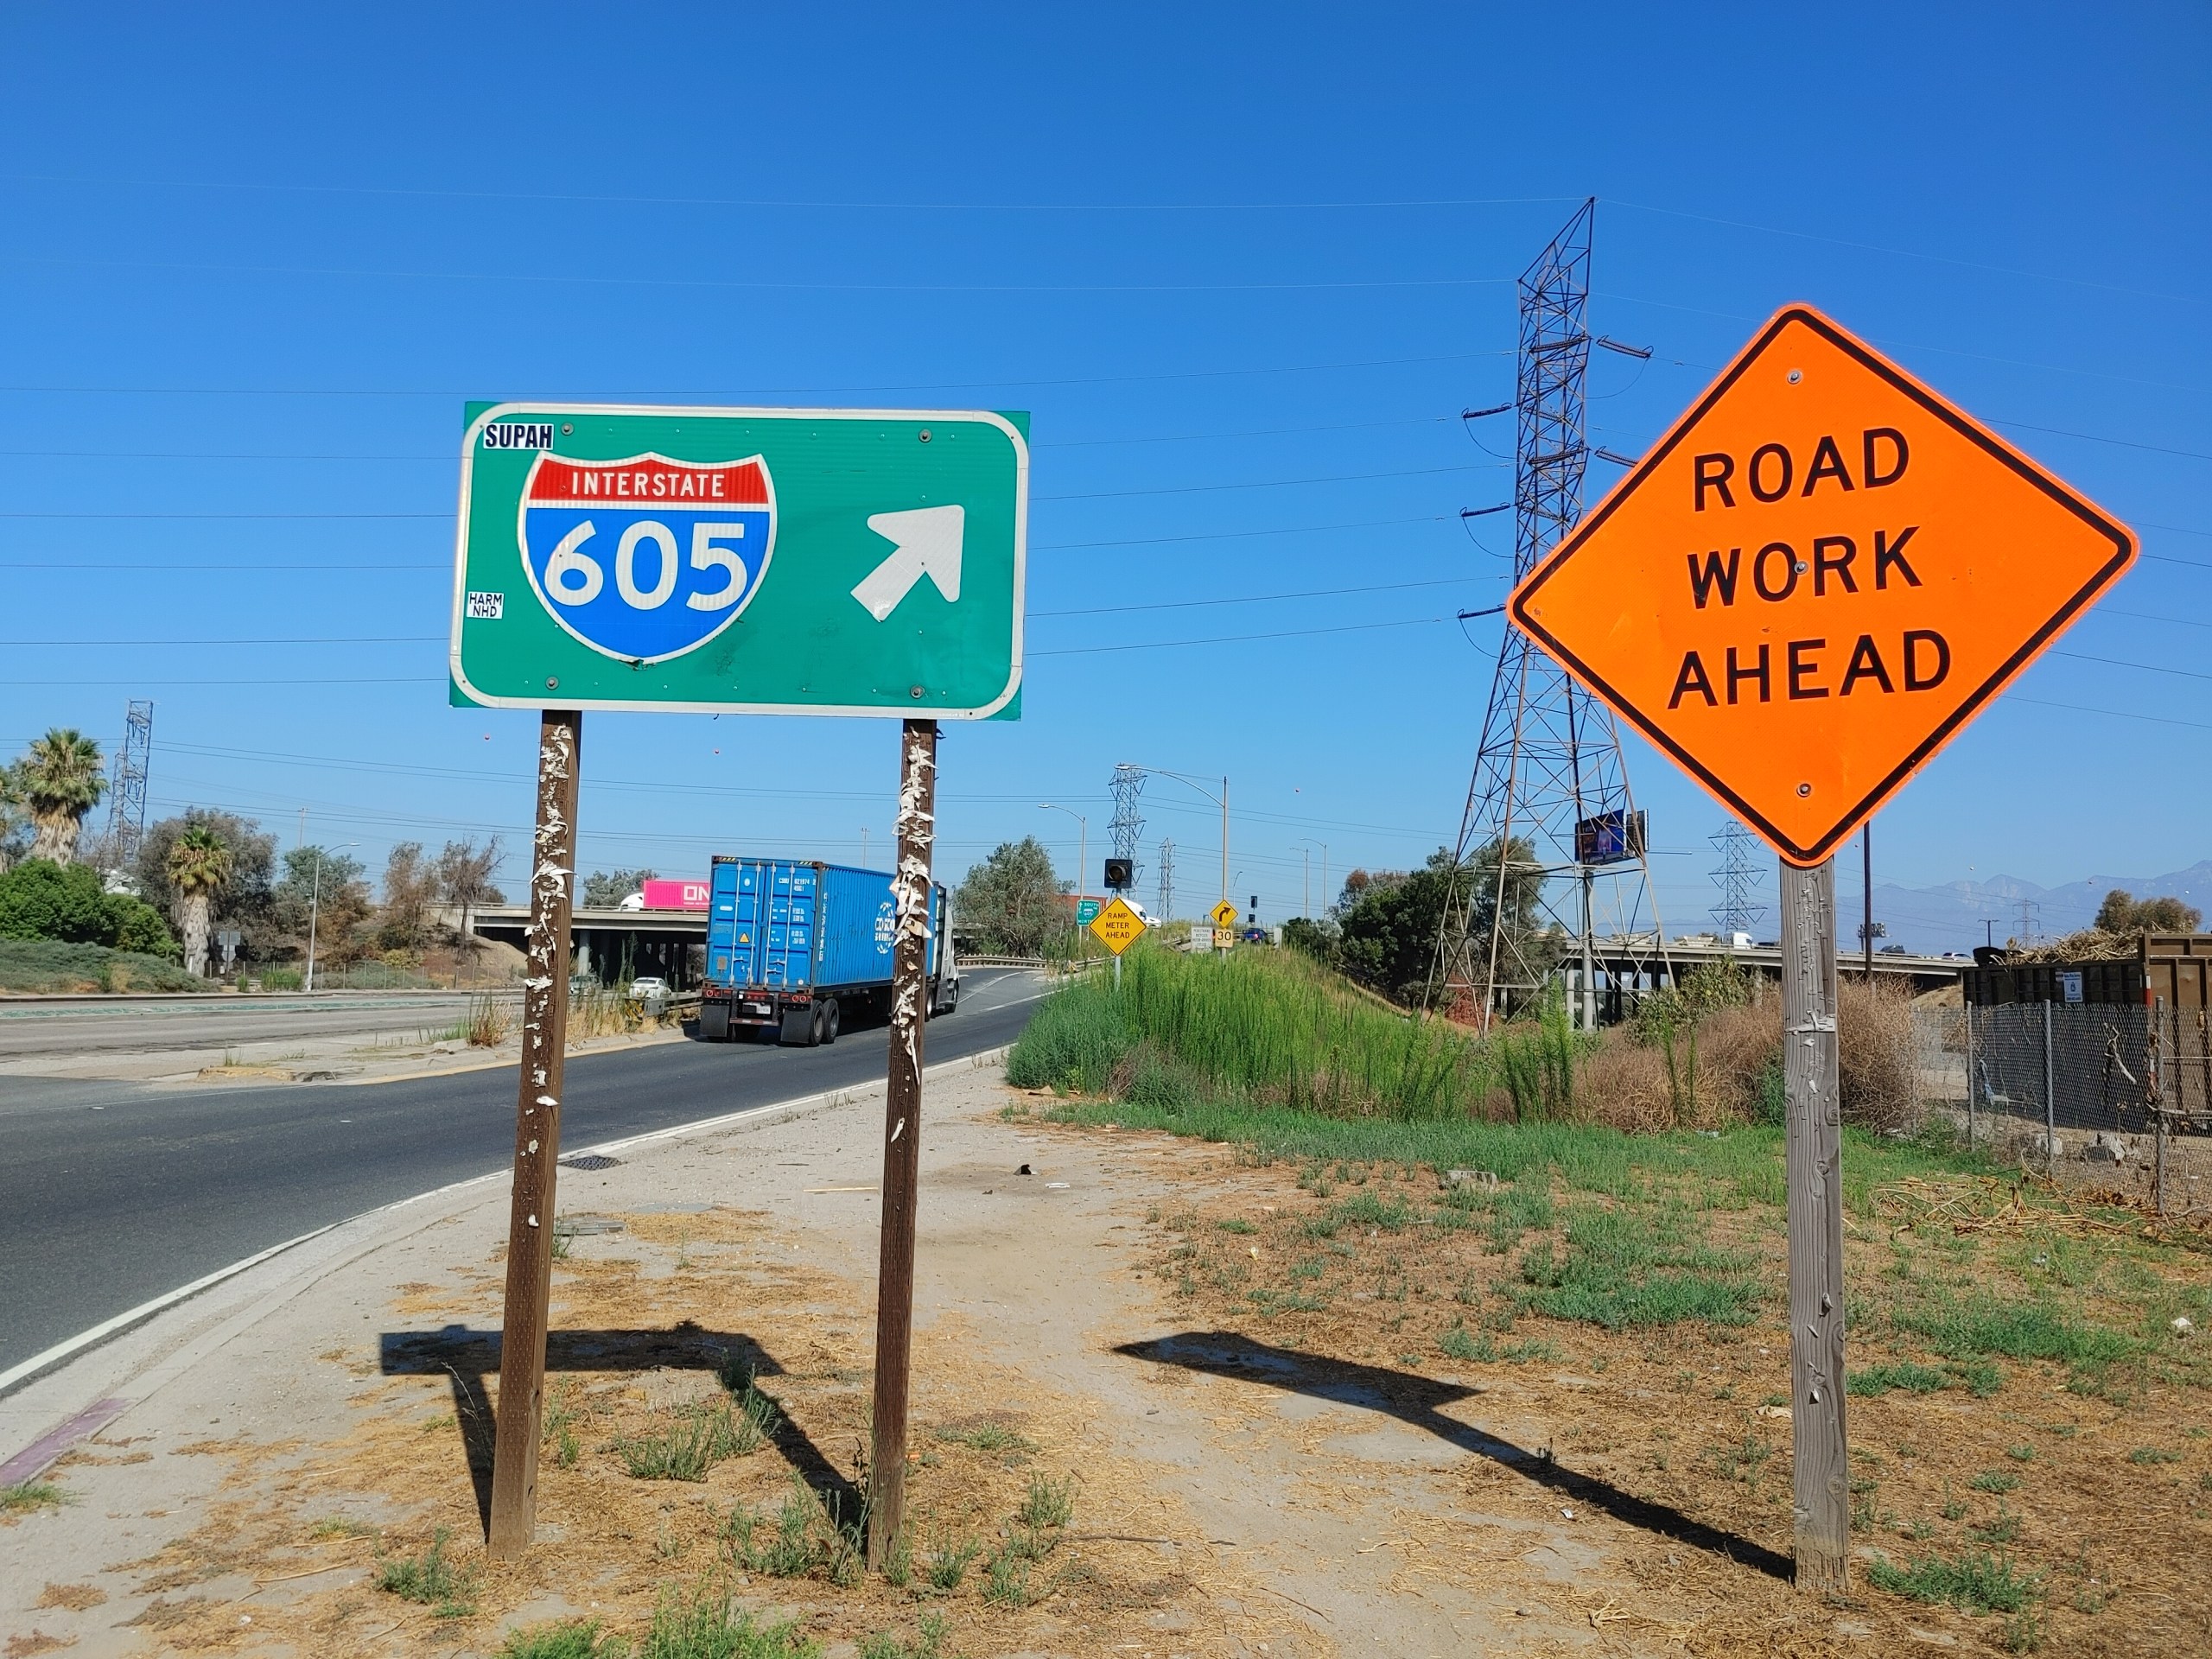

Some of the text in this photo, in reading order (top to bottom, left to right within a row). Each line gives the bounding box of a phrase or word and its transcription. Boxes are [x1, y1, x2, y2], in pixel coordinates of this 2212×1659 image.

[485, 423, 553, 448] SUPAH
[1694, 427, 1910, 512] ROAD
[571, 472, 726, 498] INTERSTATE
[543, 519, 748, 612] 605
[1688, 526, 1924, 610] WORK
[468, 593, 503, 606] HARM
[472, 605, 498, 618] NHD
[1667, 629, 1952, 709] AHEAD
[1217, 931, 1232, 941] 30
